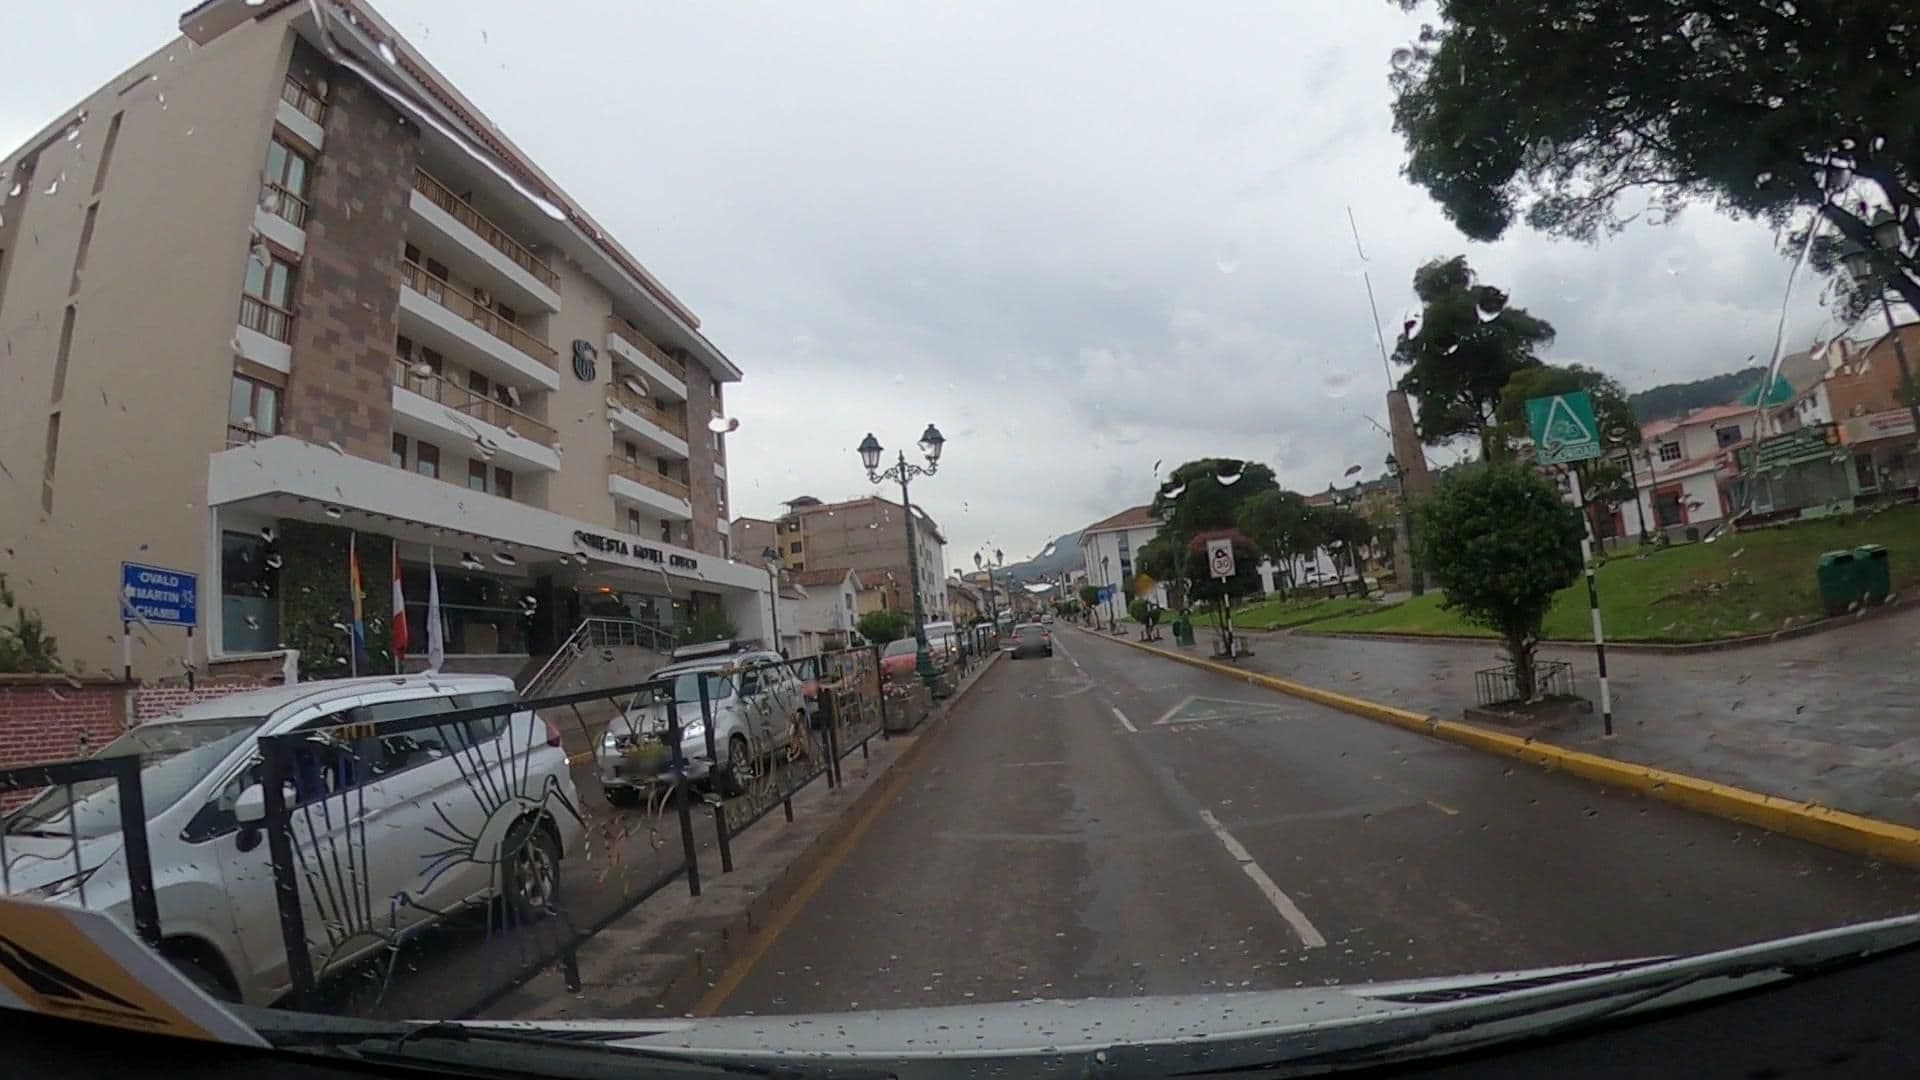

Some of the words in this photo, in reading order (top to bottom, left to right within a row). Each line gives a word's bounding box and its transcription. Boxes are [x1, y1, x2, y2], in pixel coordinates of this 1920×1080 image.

[633, 544, 664, 564] HOTEL
[139, 572, 179, 587] OVALO
[136, 587, 180, 603] MARTIN
